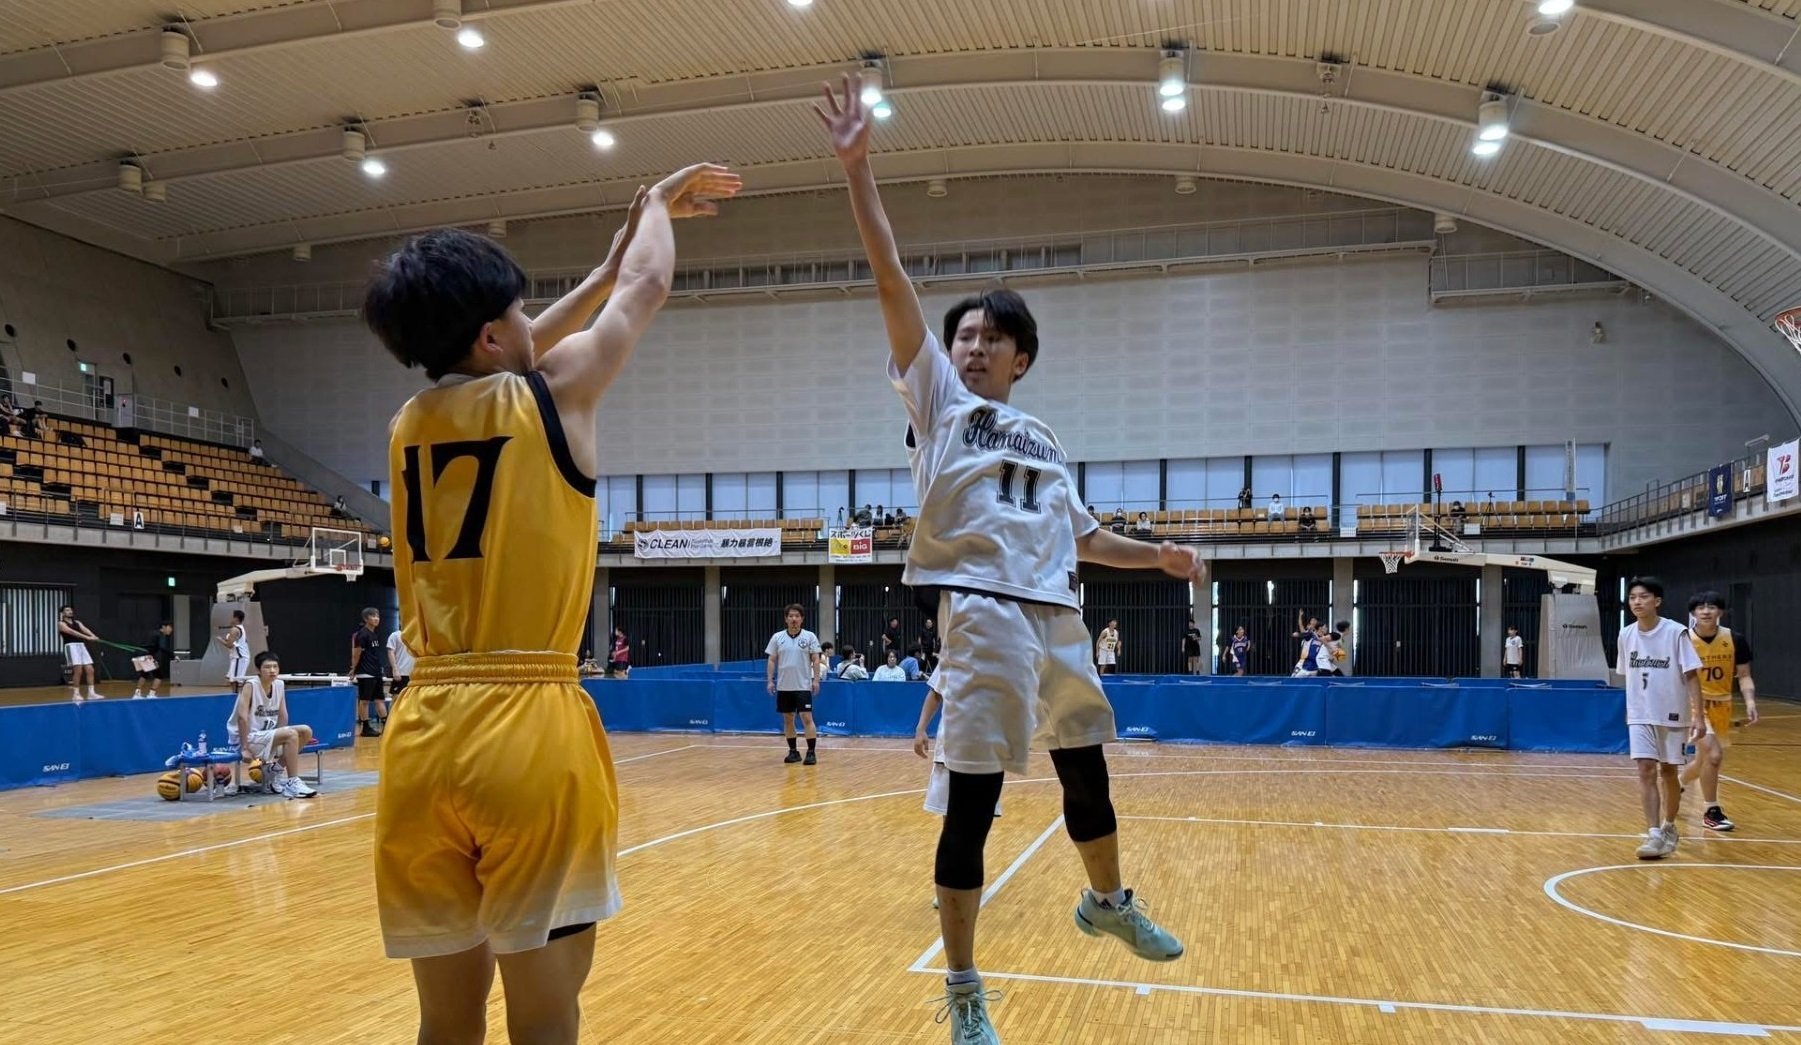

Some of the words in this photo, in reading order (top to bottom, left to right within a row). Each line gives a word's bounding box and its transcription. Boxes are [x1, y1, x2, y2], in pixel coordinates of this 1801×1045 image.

[963, 406, 1062, 464] Hamaizum
[997, 459, 1042, 515] 11
[402, 436, 514, 563] 17
[135, 512, 143, 528] A
[830, 530, 871, 539] スポーツくじ
[650, 538, 688, 549] CLEAN
[1702, 666, 1724, 682] 70
